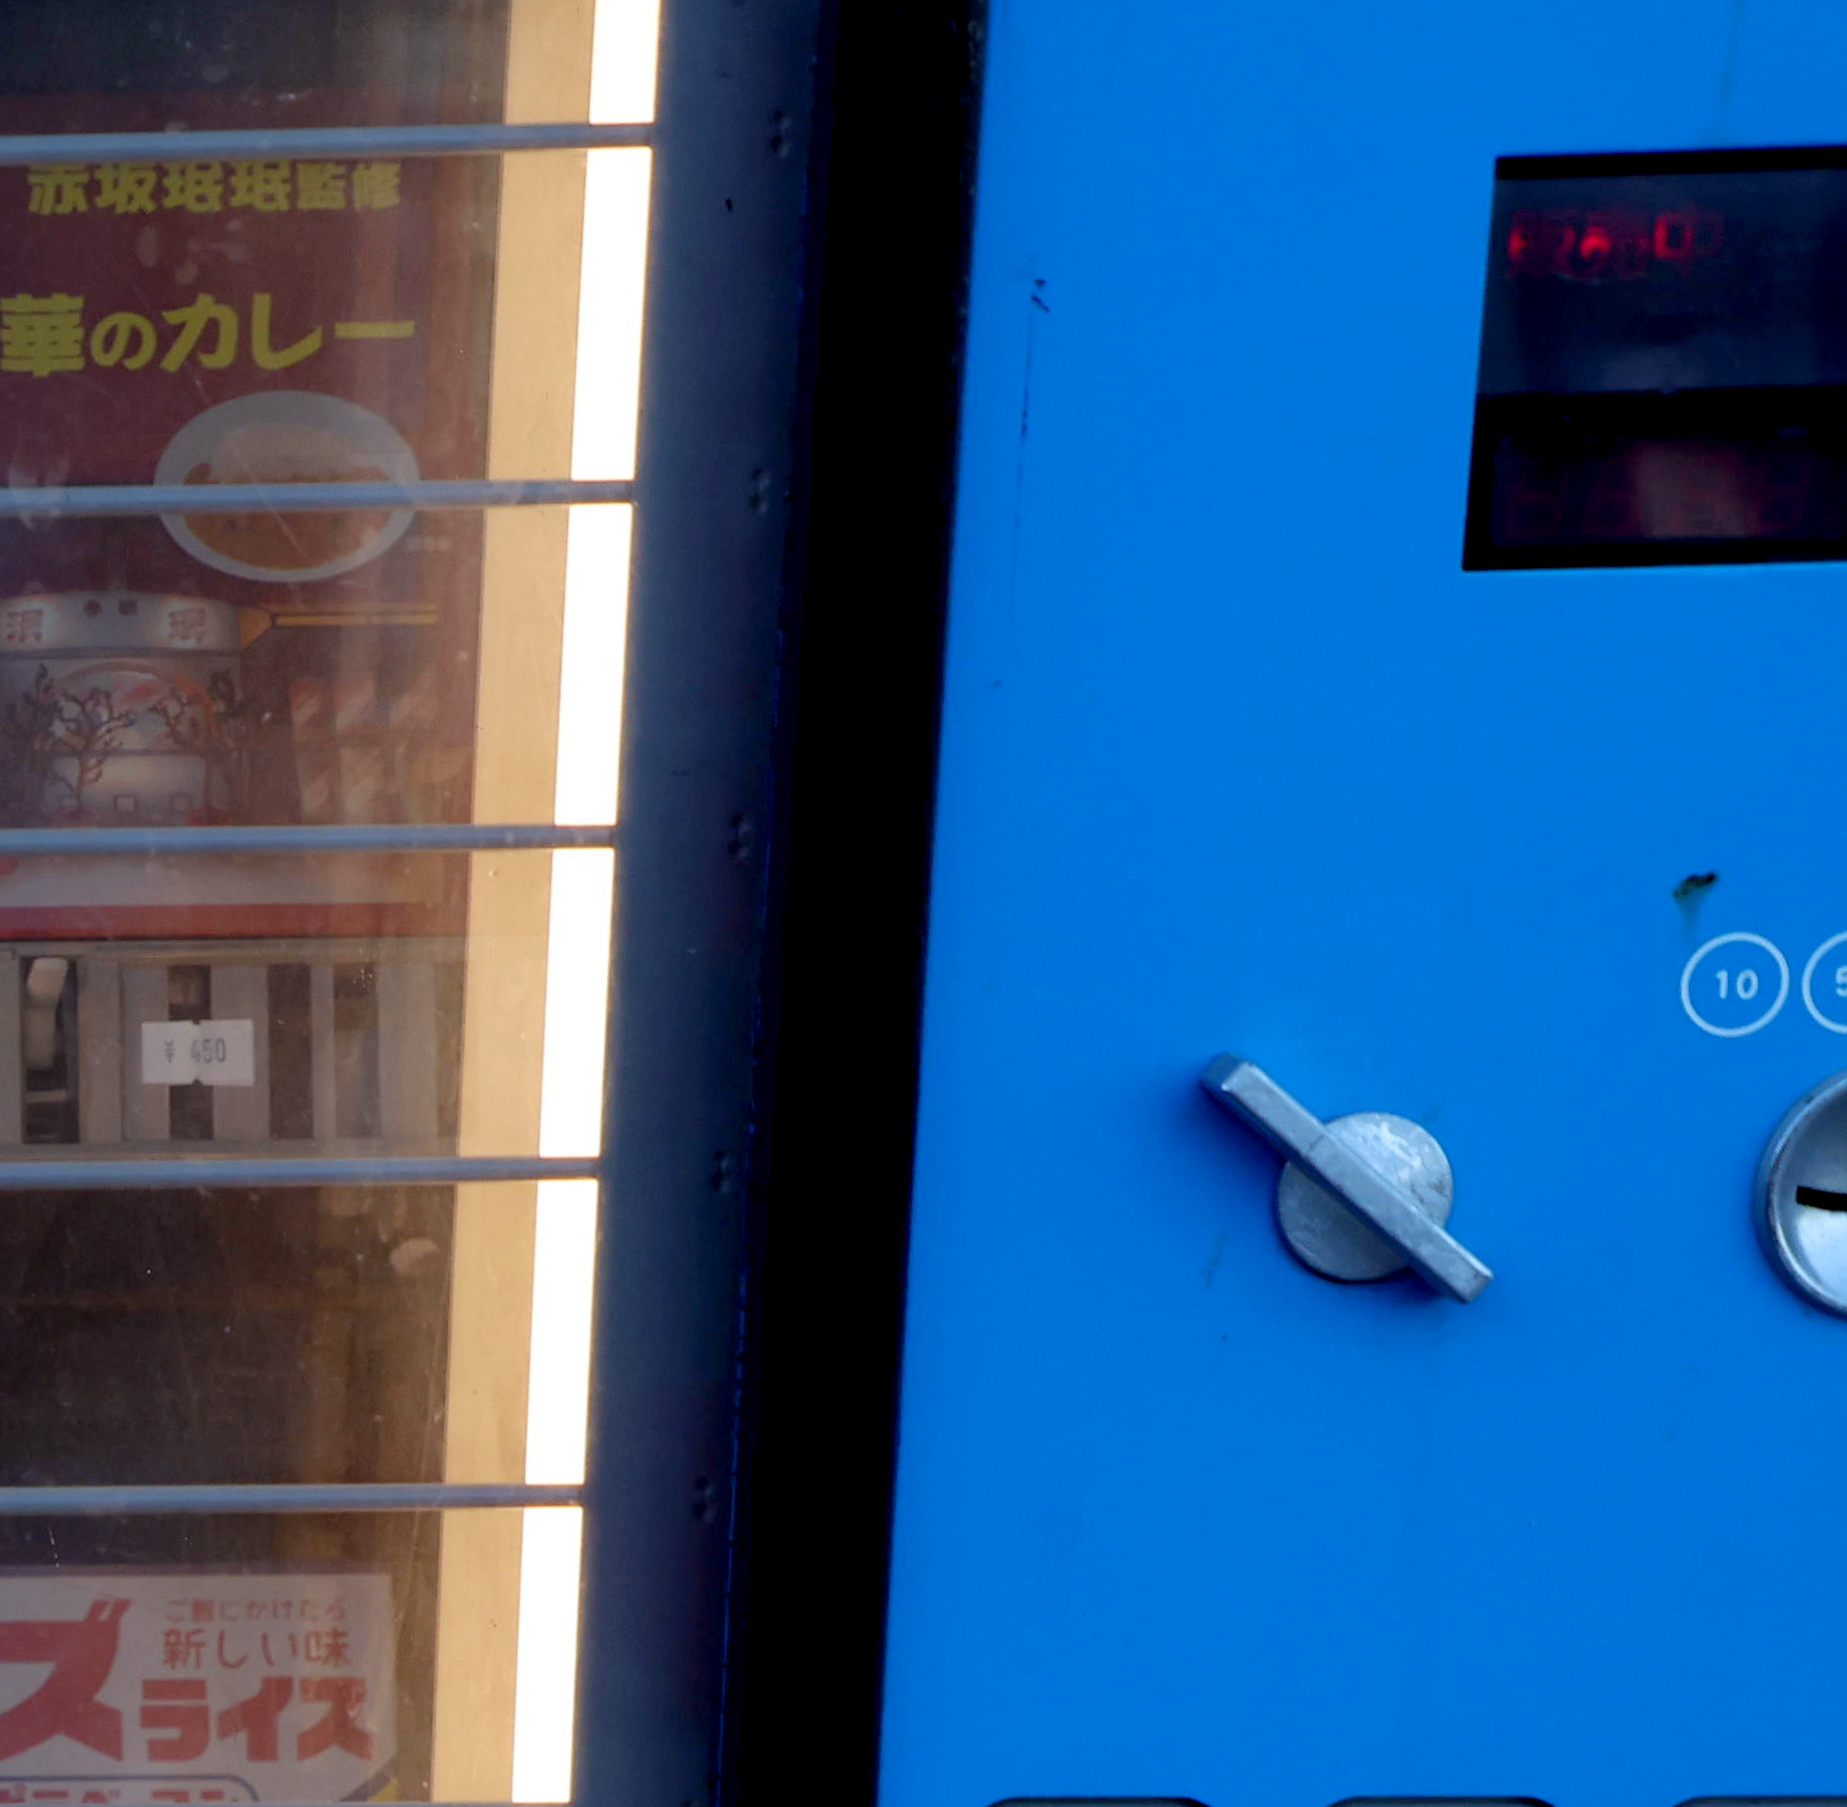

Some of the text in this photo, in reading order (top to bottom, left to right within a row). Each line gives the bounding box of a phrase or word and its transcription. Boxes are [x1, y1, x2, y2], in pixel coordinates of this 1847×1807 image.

[1716, 970, 1758, 1000] 10
[161, 1628, 351, 1670] 新しい味
[140, 1676, 374, 1763] ライス
